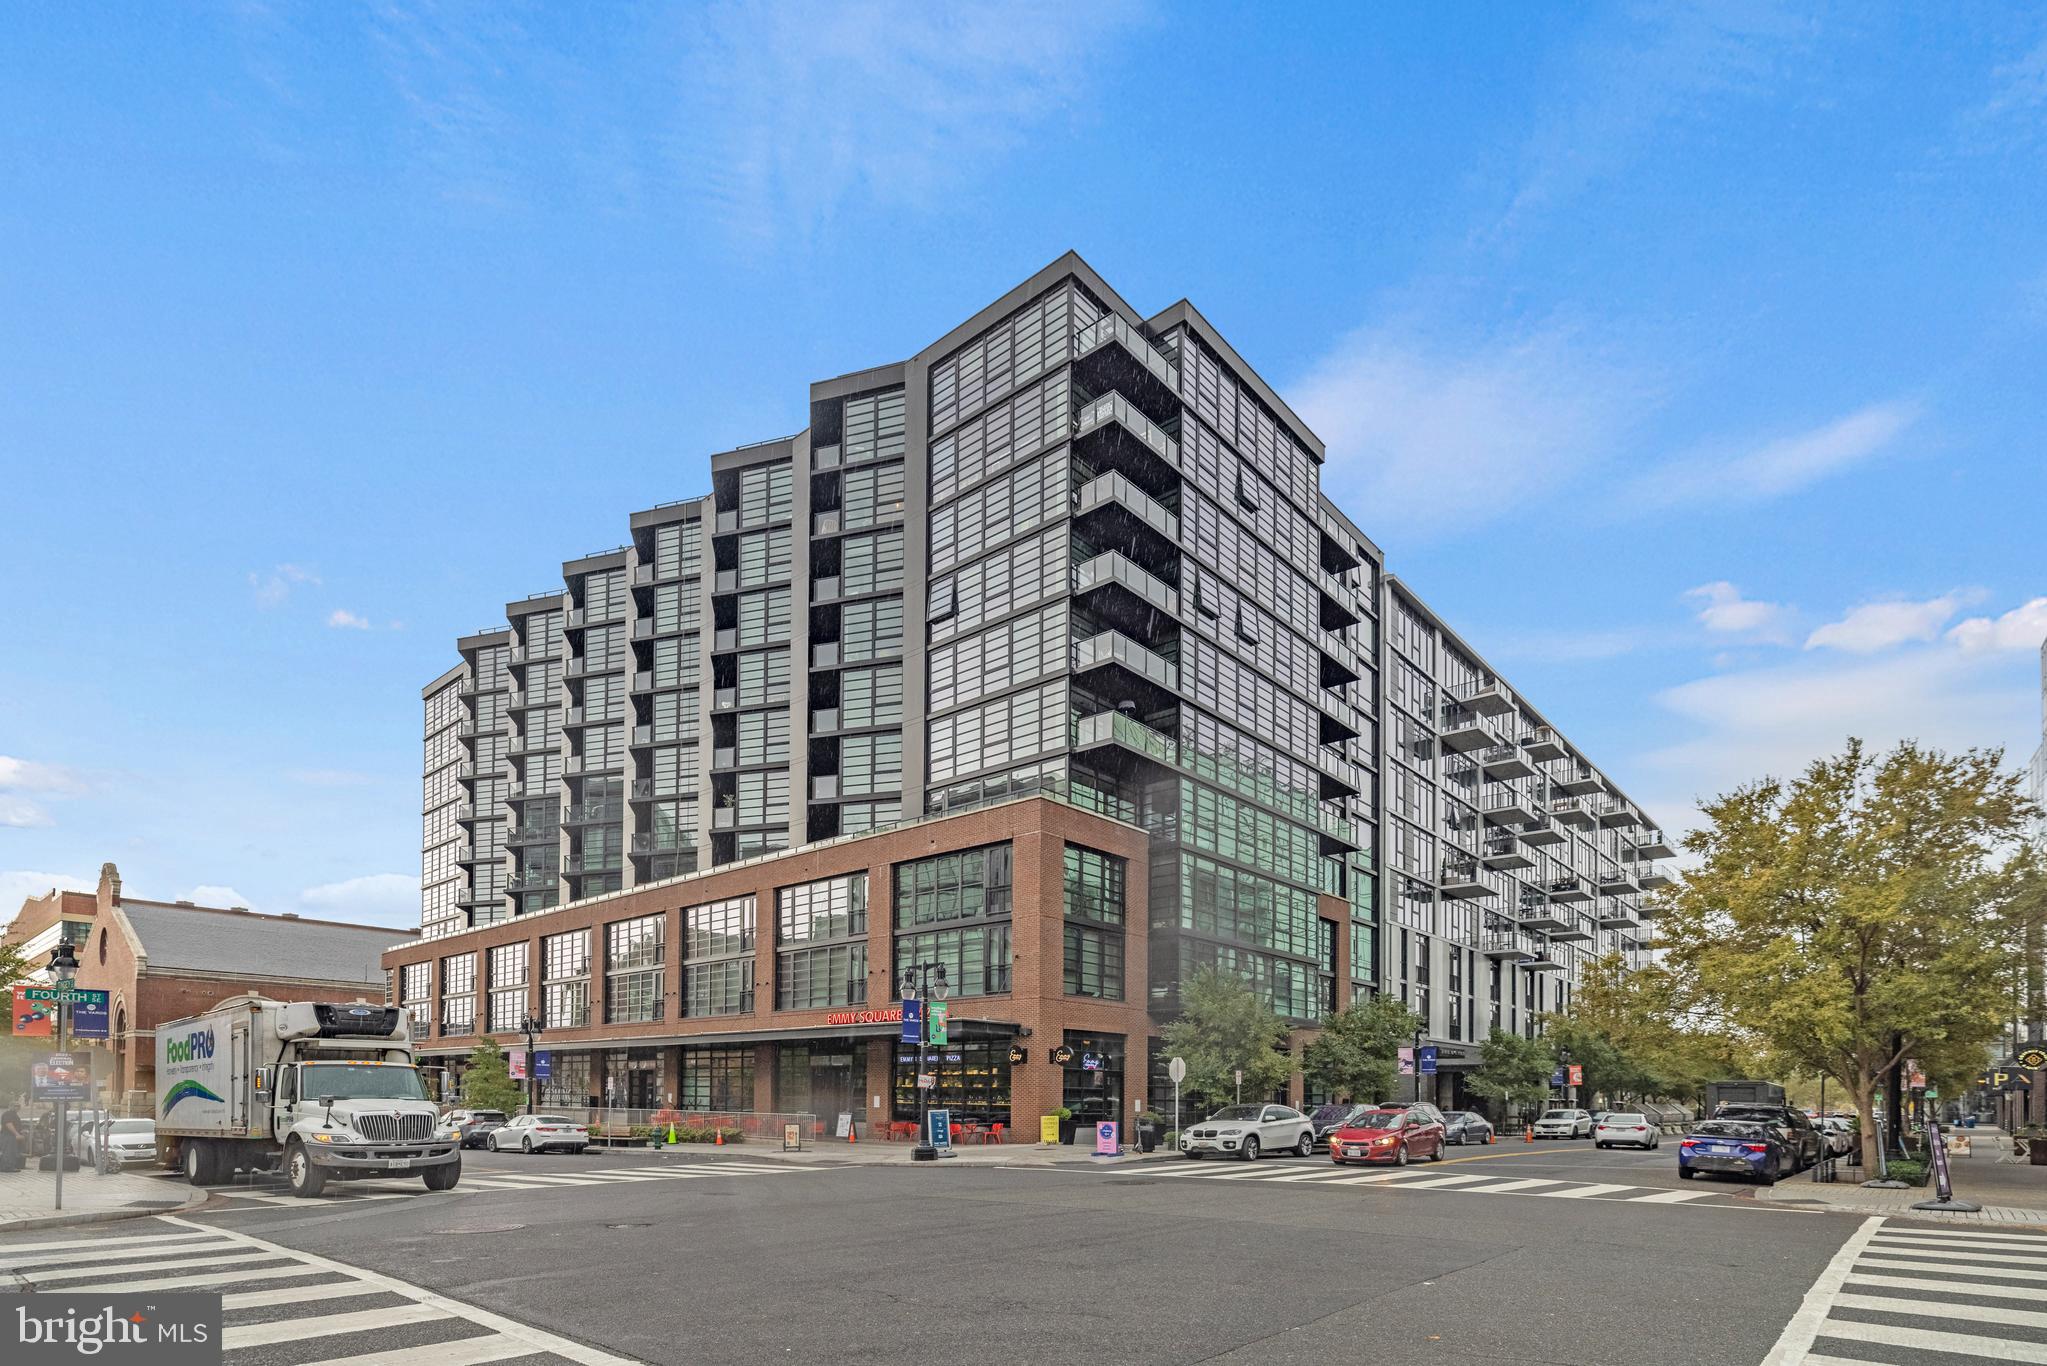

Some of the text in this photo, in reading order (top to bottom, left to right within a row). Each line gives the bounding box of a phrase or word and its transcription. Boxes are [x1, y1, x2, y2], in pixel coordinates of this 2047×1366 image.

[32, 990, 87, 1002] FOURTH
[827, 1012, 857, 1025] EMMY
[859, 1009, 903, 1023] SQUARE
[167, 1025, 214, 1064] FoodPRO
